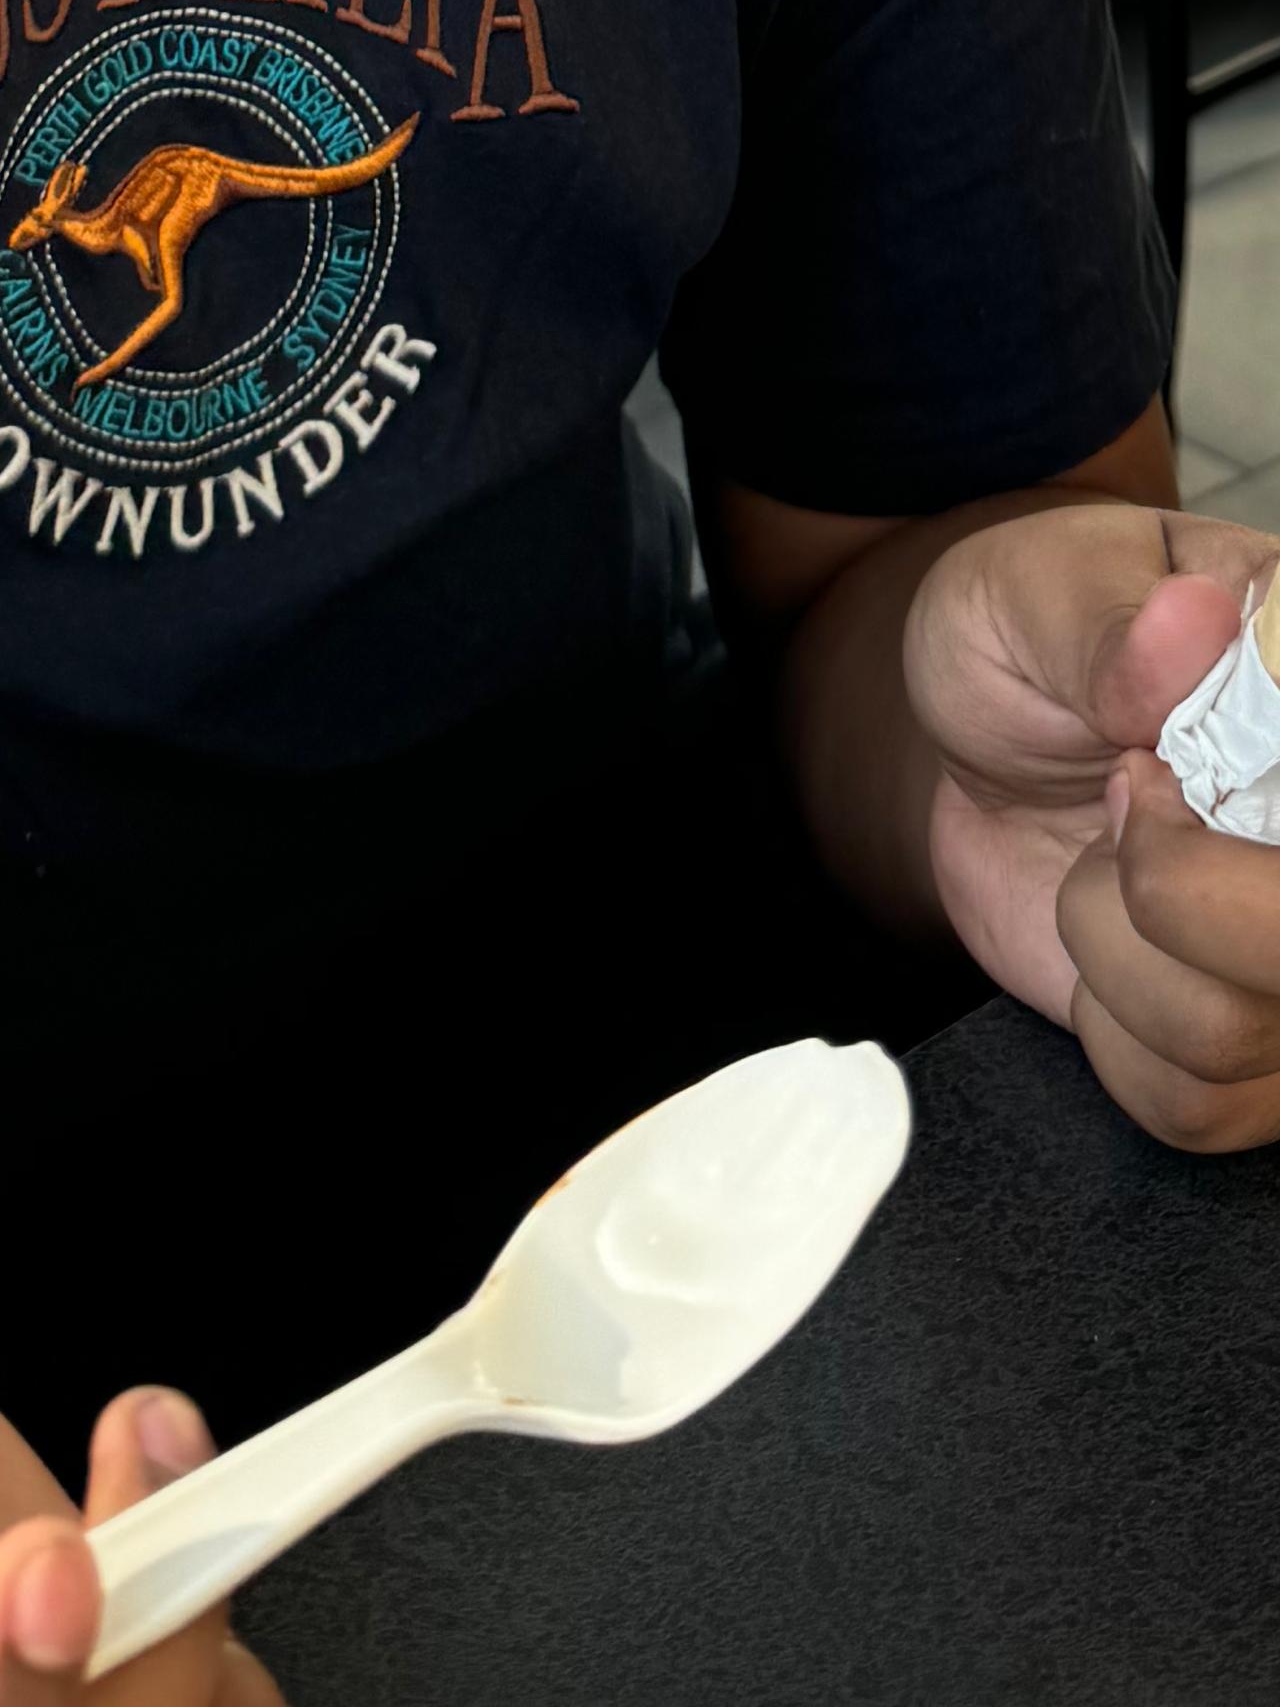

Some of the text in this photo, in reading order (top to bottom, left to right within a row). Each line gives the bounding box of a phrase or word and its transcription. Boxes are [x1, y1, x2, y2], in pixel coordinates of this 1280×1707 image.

[14, 29, 367, 186] PERTH GOLD COAST BRISBANE
[282, 223, 371, 372] SYDNEY
[73, 367, 271, 439] MELBOURNE
